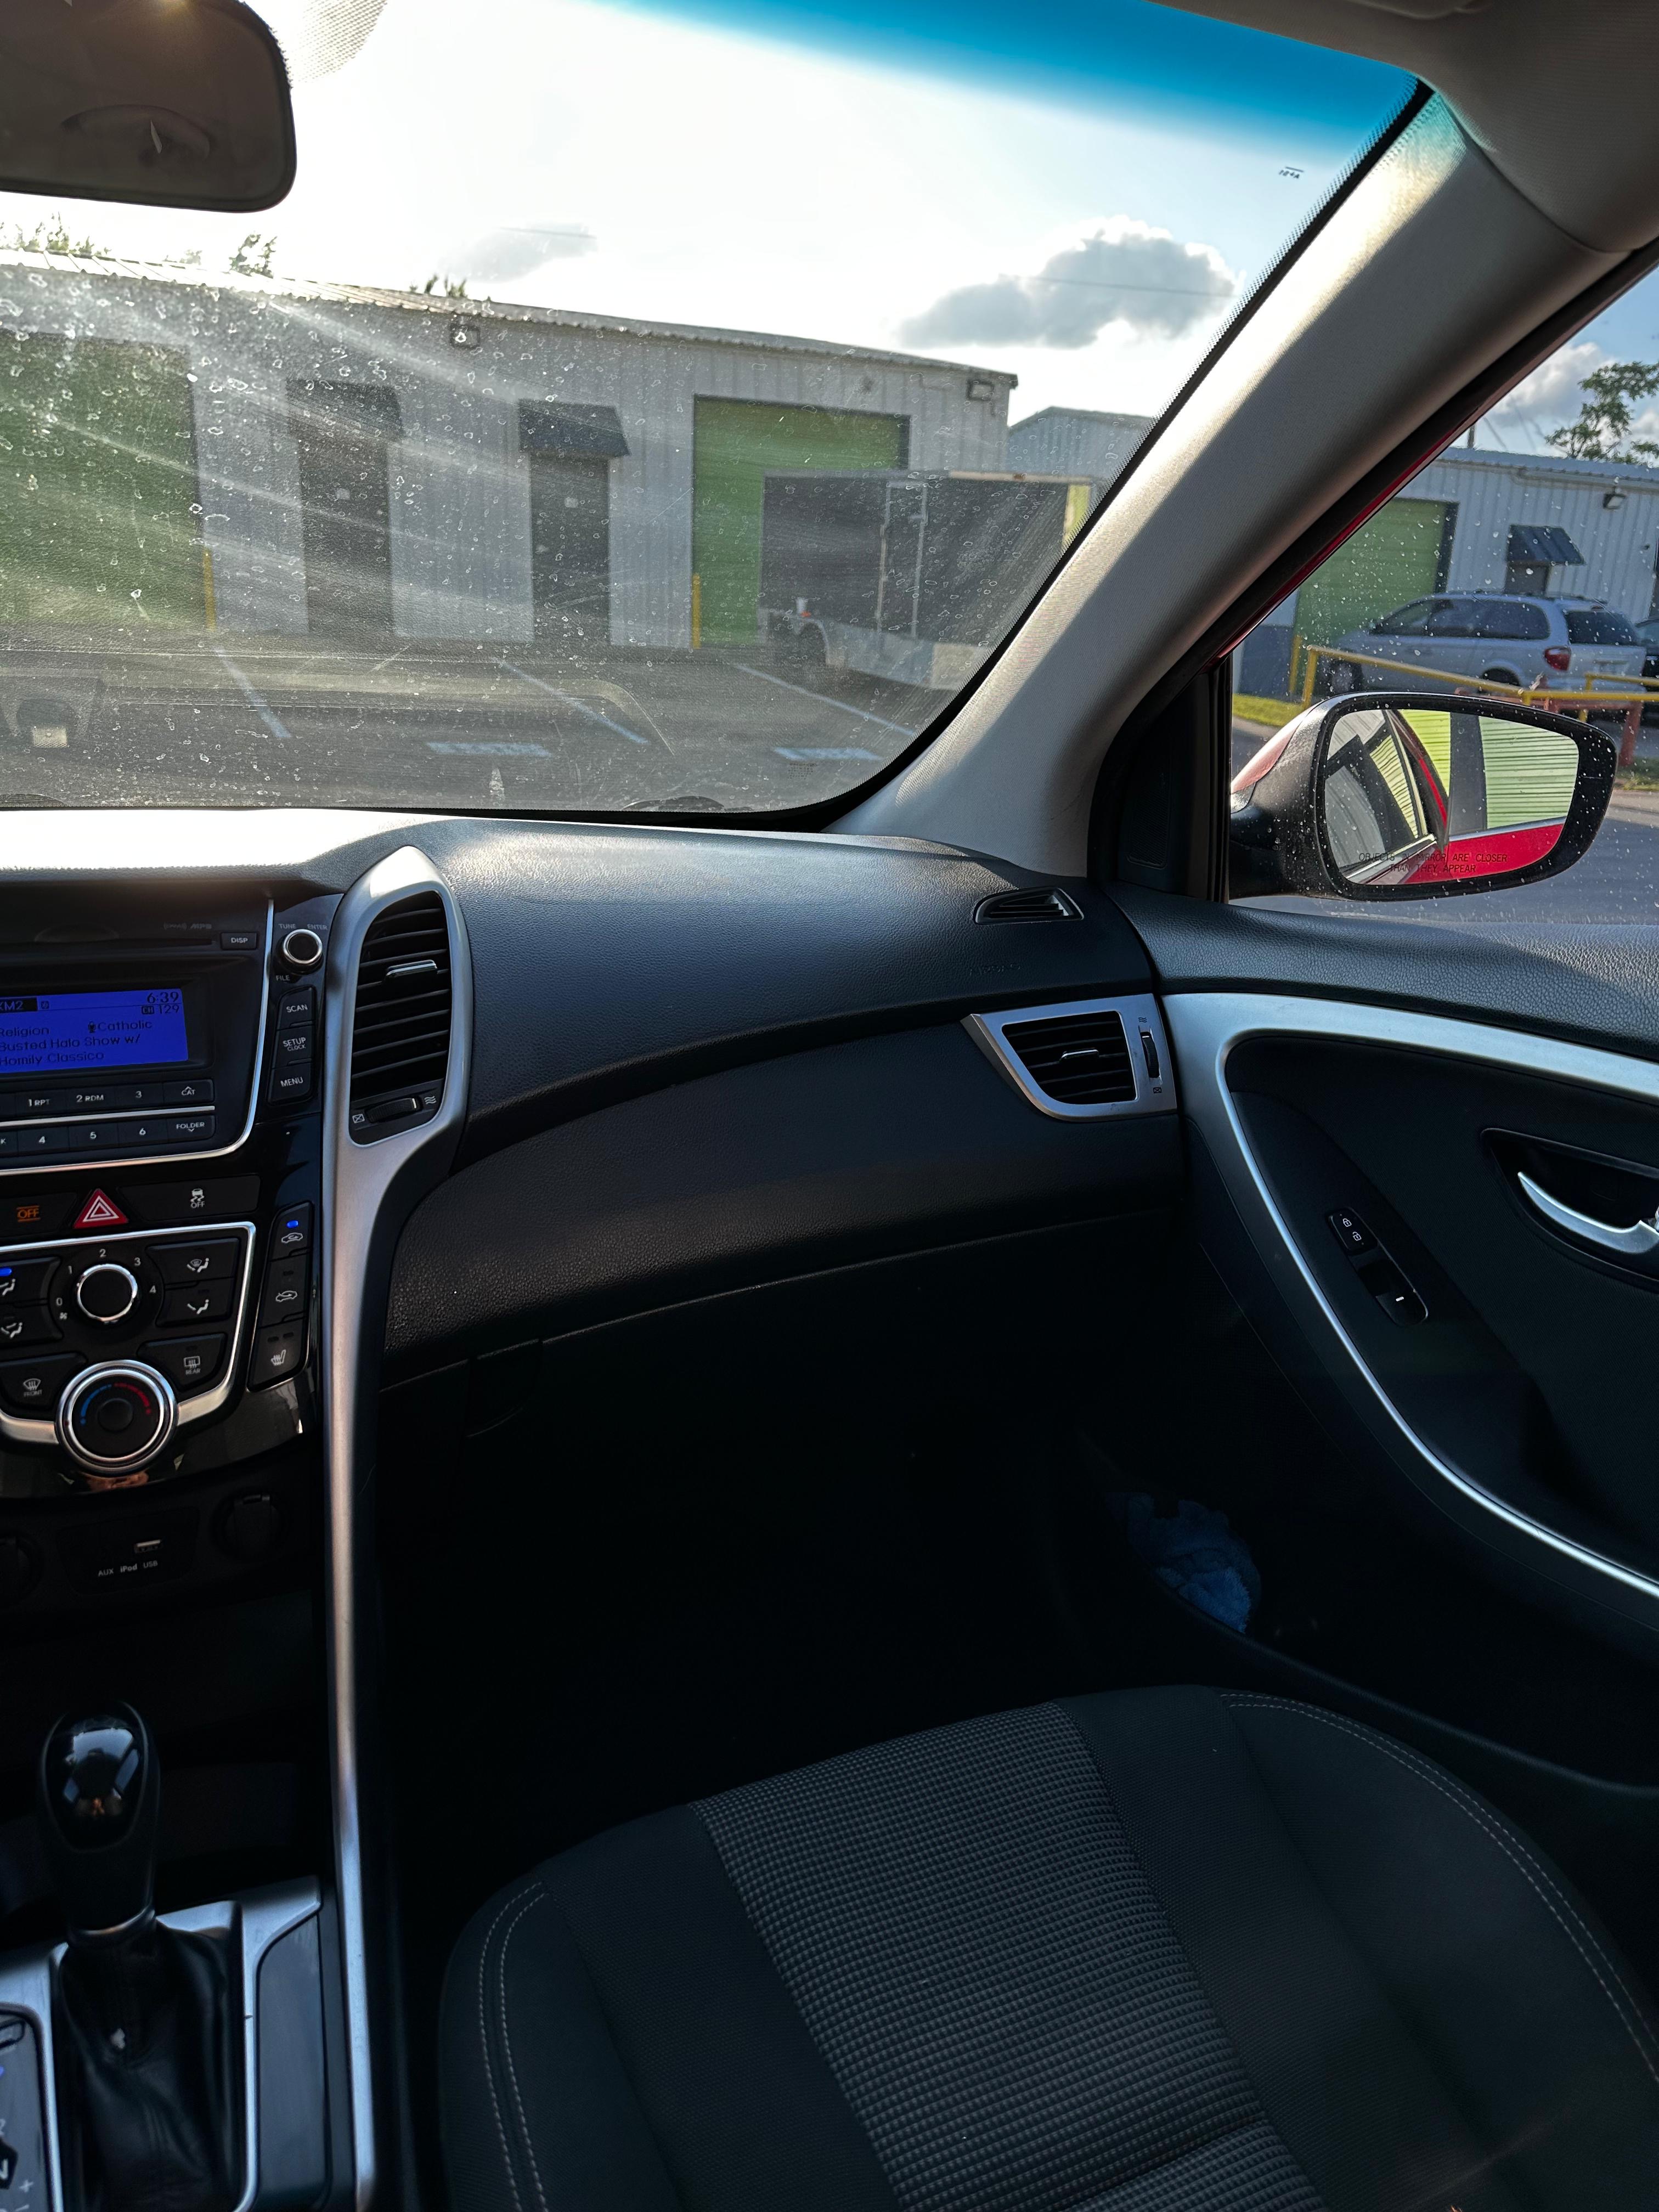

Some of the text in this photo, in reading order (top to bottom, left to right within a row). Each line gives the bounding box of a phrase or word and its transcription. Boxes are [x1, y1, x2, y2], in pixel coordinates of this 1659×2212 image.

[1358, 853, 1395, 861] OBJECTS
[1417, 853, 1446, 861] MIRROR
[1452, 853, 1469, 862] ARE
[1476, 853, 1508, 862] CLOSER
[1417, 864, 1437, 872] THEY
[1443, 864, 1476, 872] APPEAR
[146, 991, 179, 1004] 6:39
[159, 1005, 179, 1014] 129
[286, 1003, 308, 1013] SCAN
[97, 1020, 153, 1031] Catholic
[50, 1037, 81, 1049] Halo
[84, 1035, 121, 1047] Show
[124, 1033, 141, 1043] w/
[283, 1036, 306, 1048] SETUP
[47, 1051, 104, 1063] Classico
[280, 1076, 303, 1088] MENU
[28, 1098, 50, 1108] 1 RPT
[76, 1094, 105, 1103] 2 RDM
[176, 1121, 206, 1130] FOLDER
[38, 1136, 47, 1144] 4
[89, 1131, 98, 1140] 5
[17, 1207, 40, 1218] OFF
[99, 1249, 107, 1257] 2
[134, 1256, 142, 1266] 3
[67, 1265, 73, 1274] 1
[149, 1285, 157, 1294] 4
[56, 1297, 63, 1306] 0
[98, 1560, 159, 1577] AUX iPod USB
